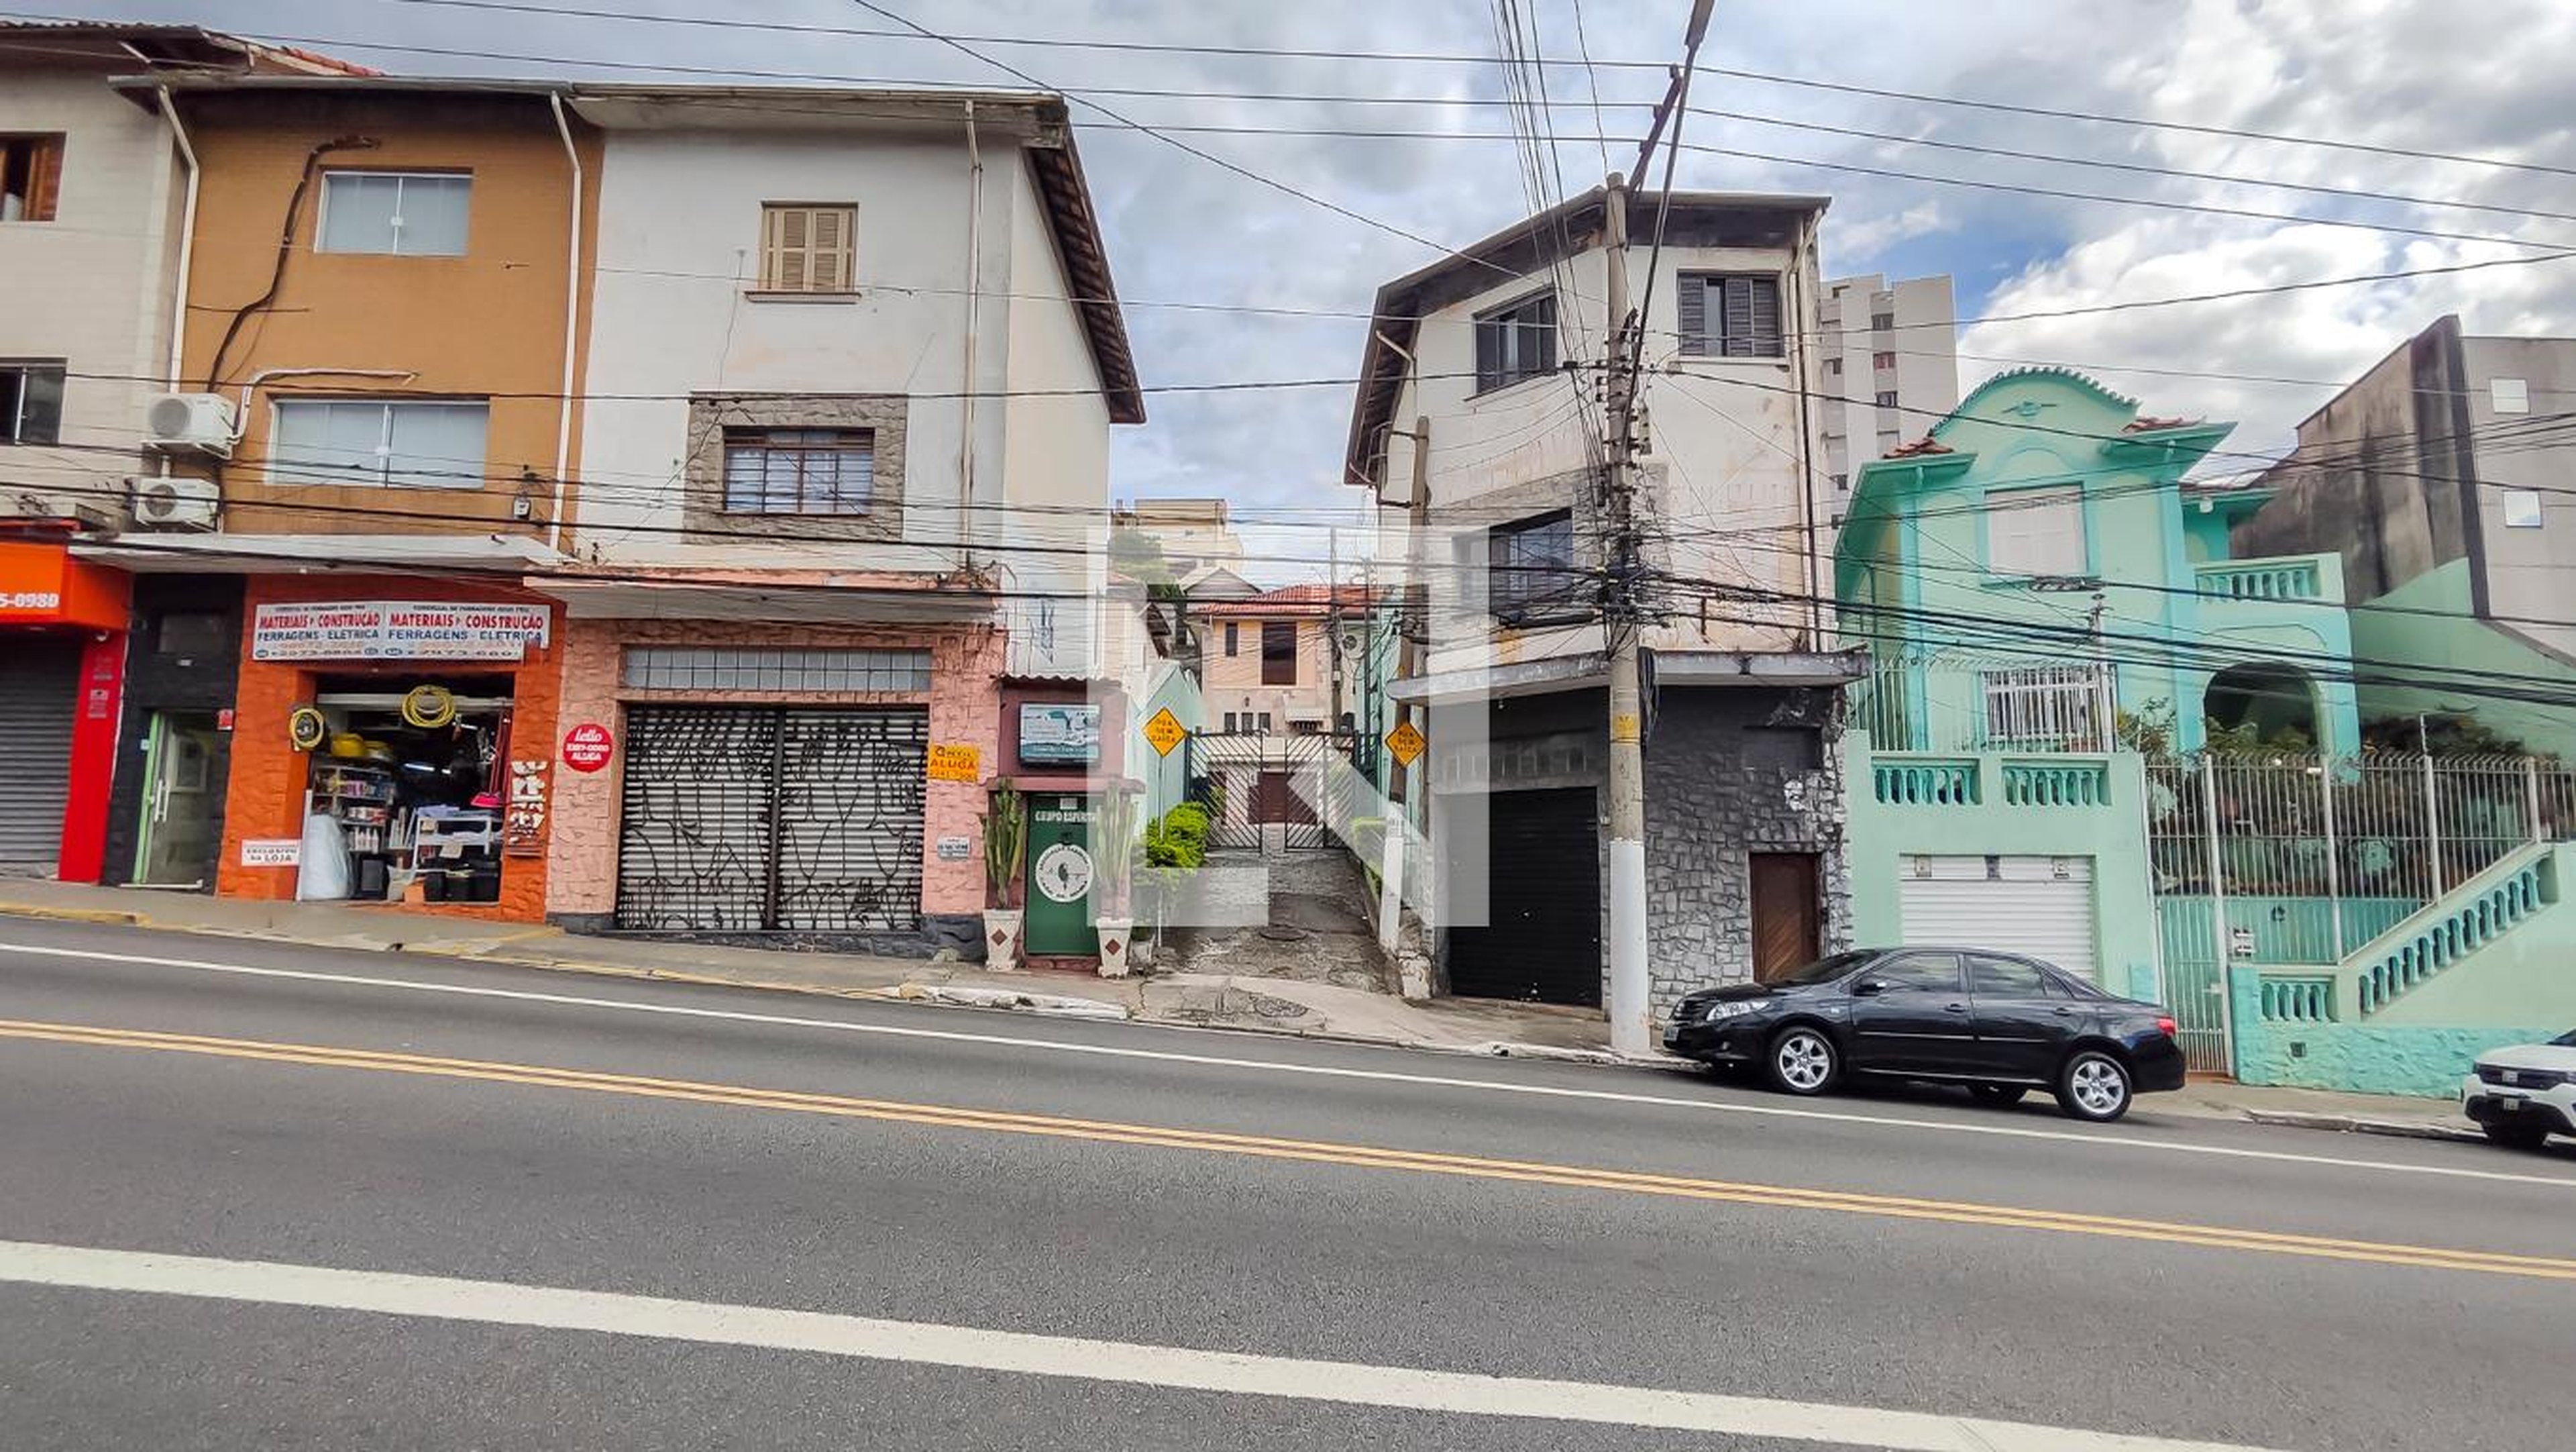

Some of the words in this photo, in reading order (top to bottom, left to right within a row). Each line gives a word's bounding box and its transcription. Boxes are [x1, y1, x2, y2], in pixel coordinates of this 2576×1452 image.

[260, 615, 309, 629] MATERIAIS
[388, 613, 454, 627] MATERIAIS
[258, 631, 319, 641] FERRAGENS
[388, 629, 468, 640] FERRAGENS
[930, 758, 976, 770] ALUGA
